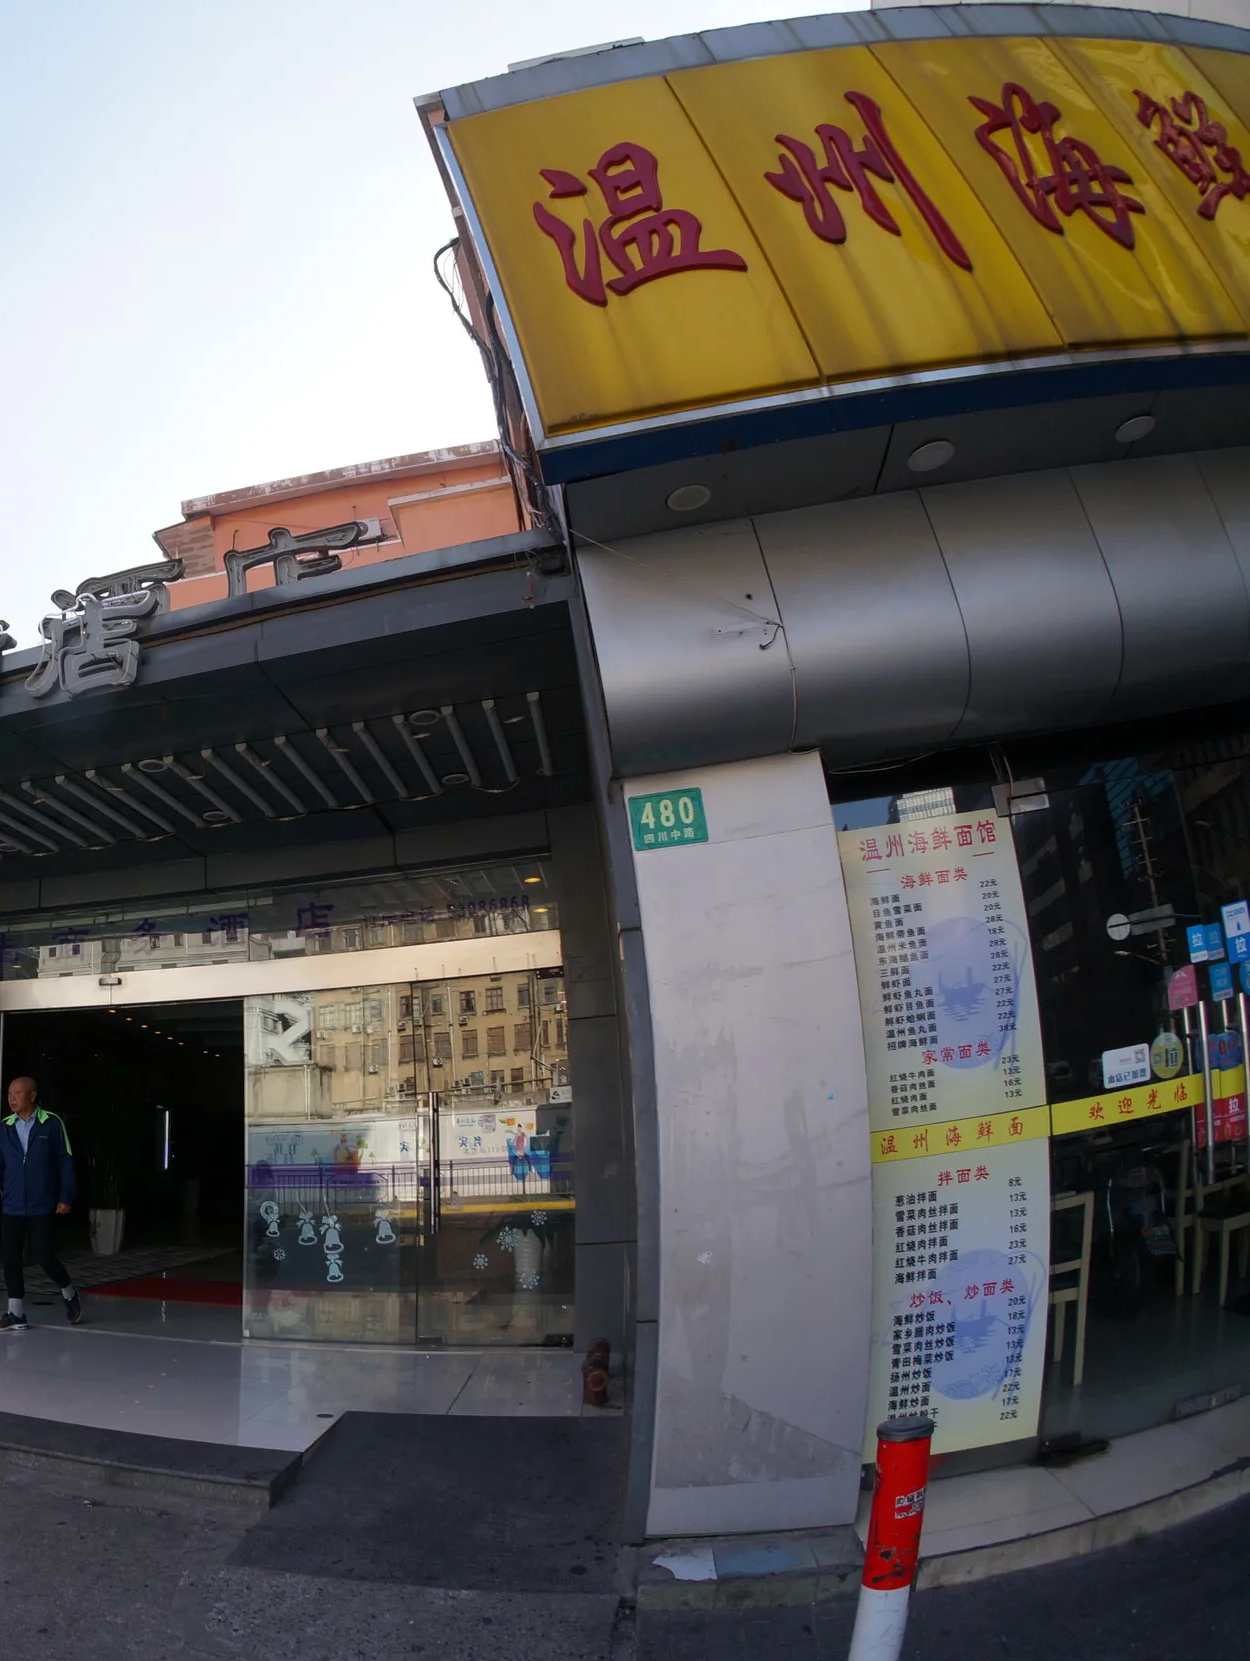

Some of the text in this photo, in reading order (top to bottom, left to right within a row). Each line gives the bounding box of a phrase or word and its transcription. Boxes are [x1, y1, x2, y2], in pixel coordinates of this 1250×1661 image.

[640, 796, 694, 829] 480
[643, 827, 695, 845] 四川中路
[858, 819, 997, 862] 温州海鲜面馆
[900, 866, 968, 889] 海鲜面类
[979, 878, 998, 888] 22元
[981, 890, 1000, 900] 20元
[983, 902, 1001, 911] 20元
[991, 962, 1010, 971] 22元
[993, 974, 1011, 983] 27元
[921, 1041, 991, 1065] 家常面类
[1001, 1054, 1020, 1064] 23元
[1004, 1077, 1022, 1087] 16元
[1004, 1088, 1023, 1099] 13元
[1088, 1082, 1188, 1120] 欢迎光临
[880, 1116, 1024, 1156] 温州海鲜面
[937, 1165, 990, 1187] 拌面类
[1008, 1176, 1022, 1187] 8元
[1009, 1191, 1027, 1202] 13元
[1009, 1207, 1027, 1218] 13元
[894, 1222, 1027, 1253] 红烧肉拌面 16元
[894, 1238, 1027, 1269] 红烧牛肉拌面 23元
[894, 1254, 1027, 1284] 海鲜拌面 27元
[1007, 1295, 1027, 1307] 20元
[1007, 1310, 1026, 1321] 18元
